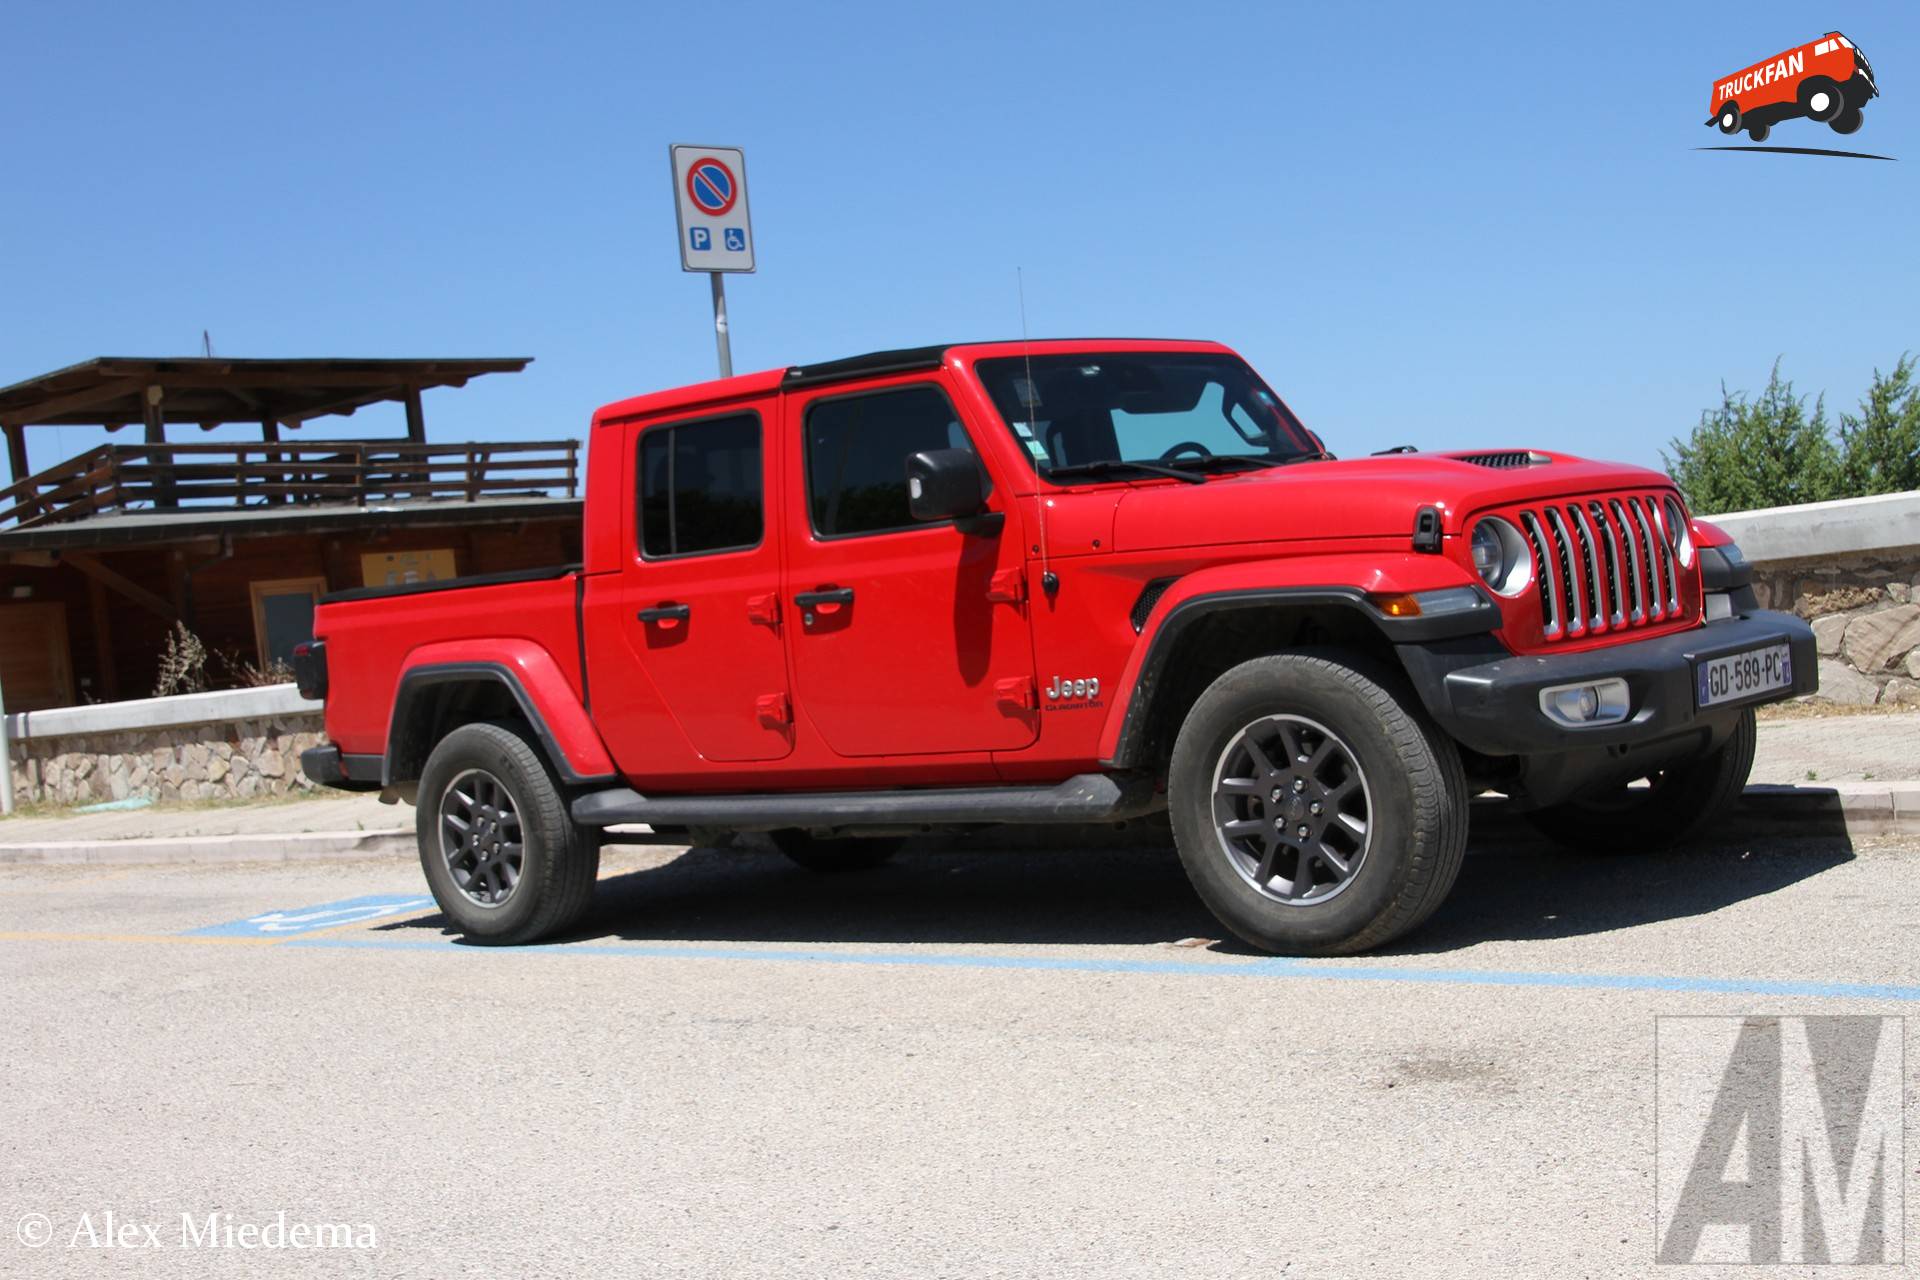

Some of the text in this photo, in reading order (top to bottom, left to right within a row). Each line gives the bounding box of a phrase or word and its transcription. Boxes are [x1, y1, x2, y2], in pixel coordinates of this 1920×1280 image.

[694, 230, 708, 249] P
[1709, 651, 1781, 697] GD-589-PC
[1045, 676, 1099, 699] Jeep
